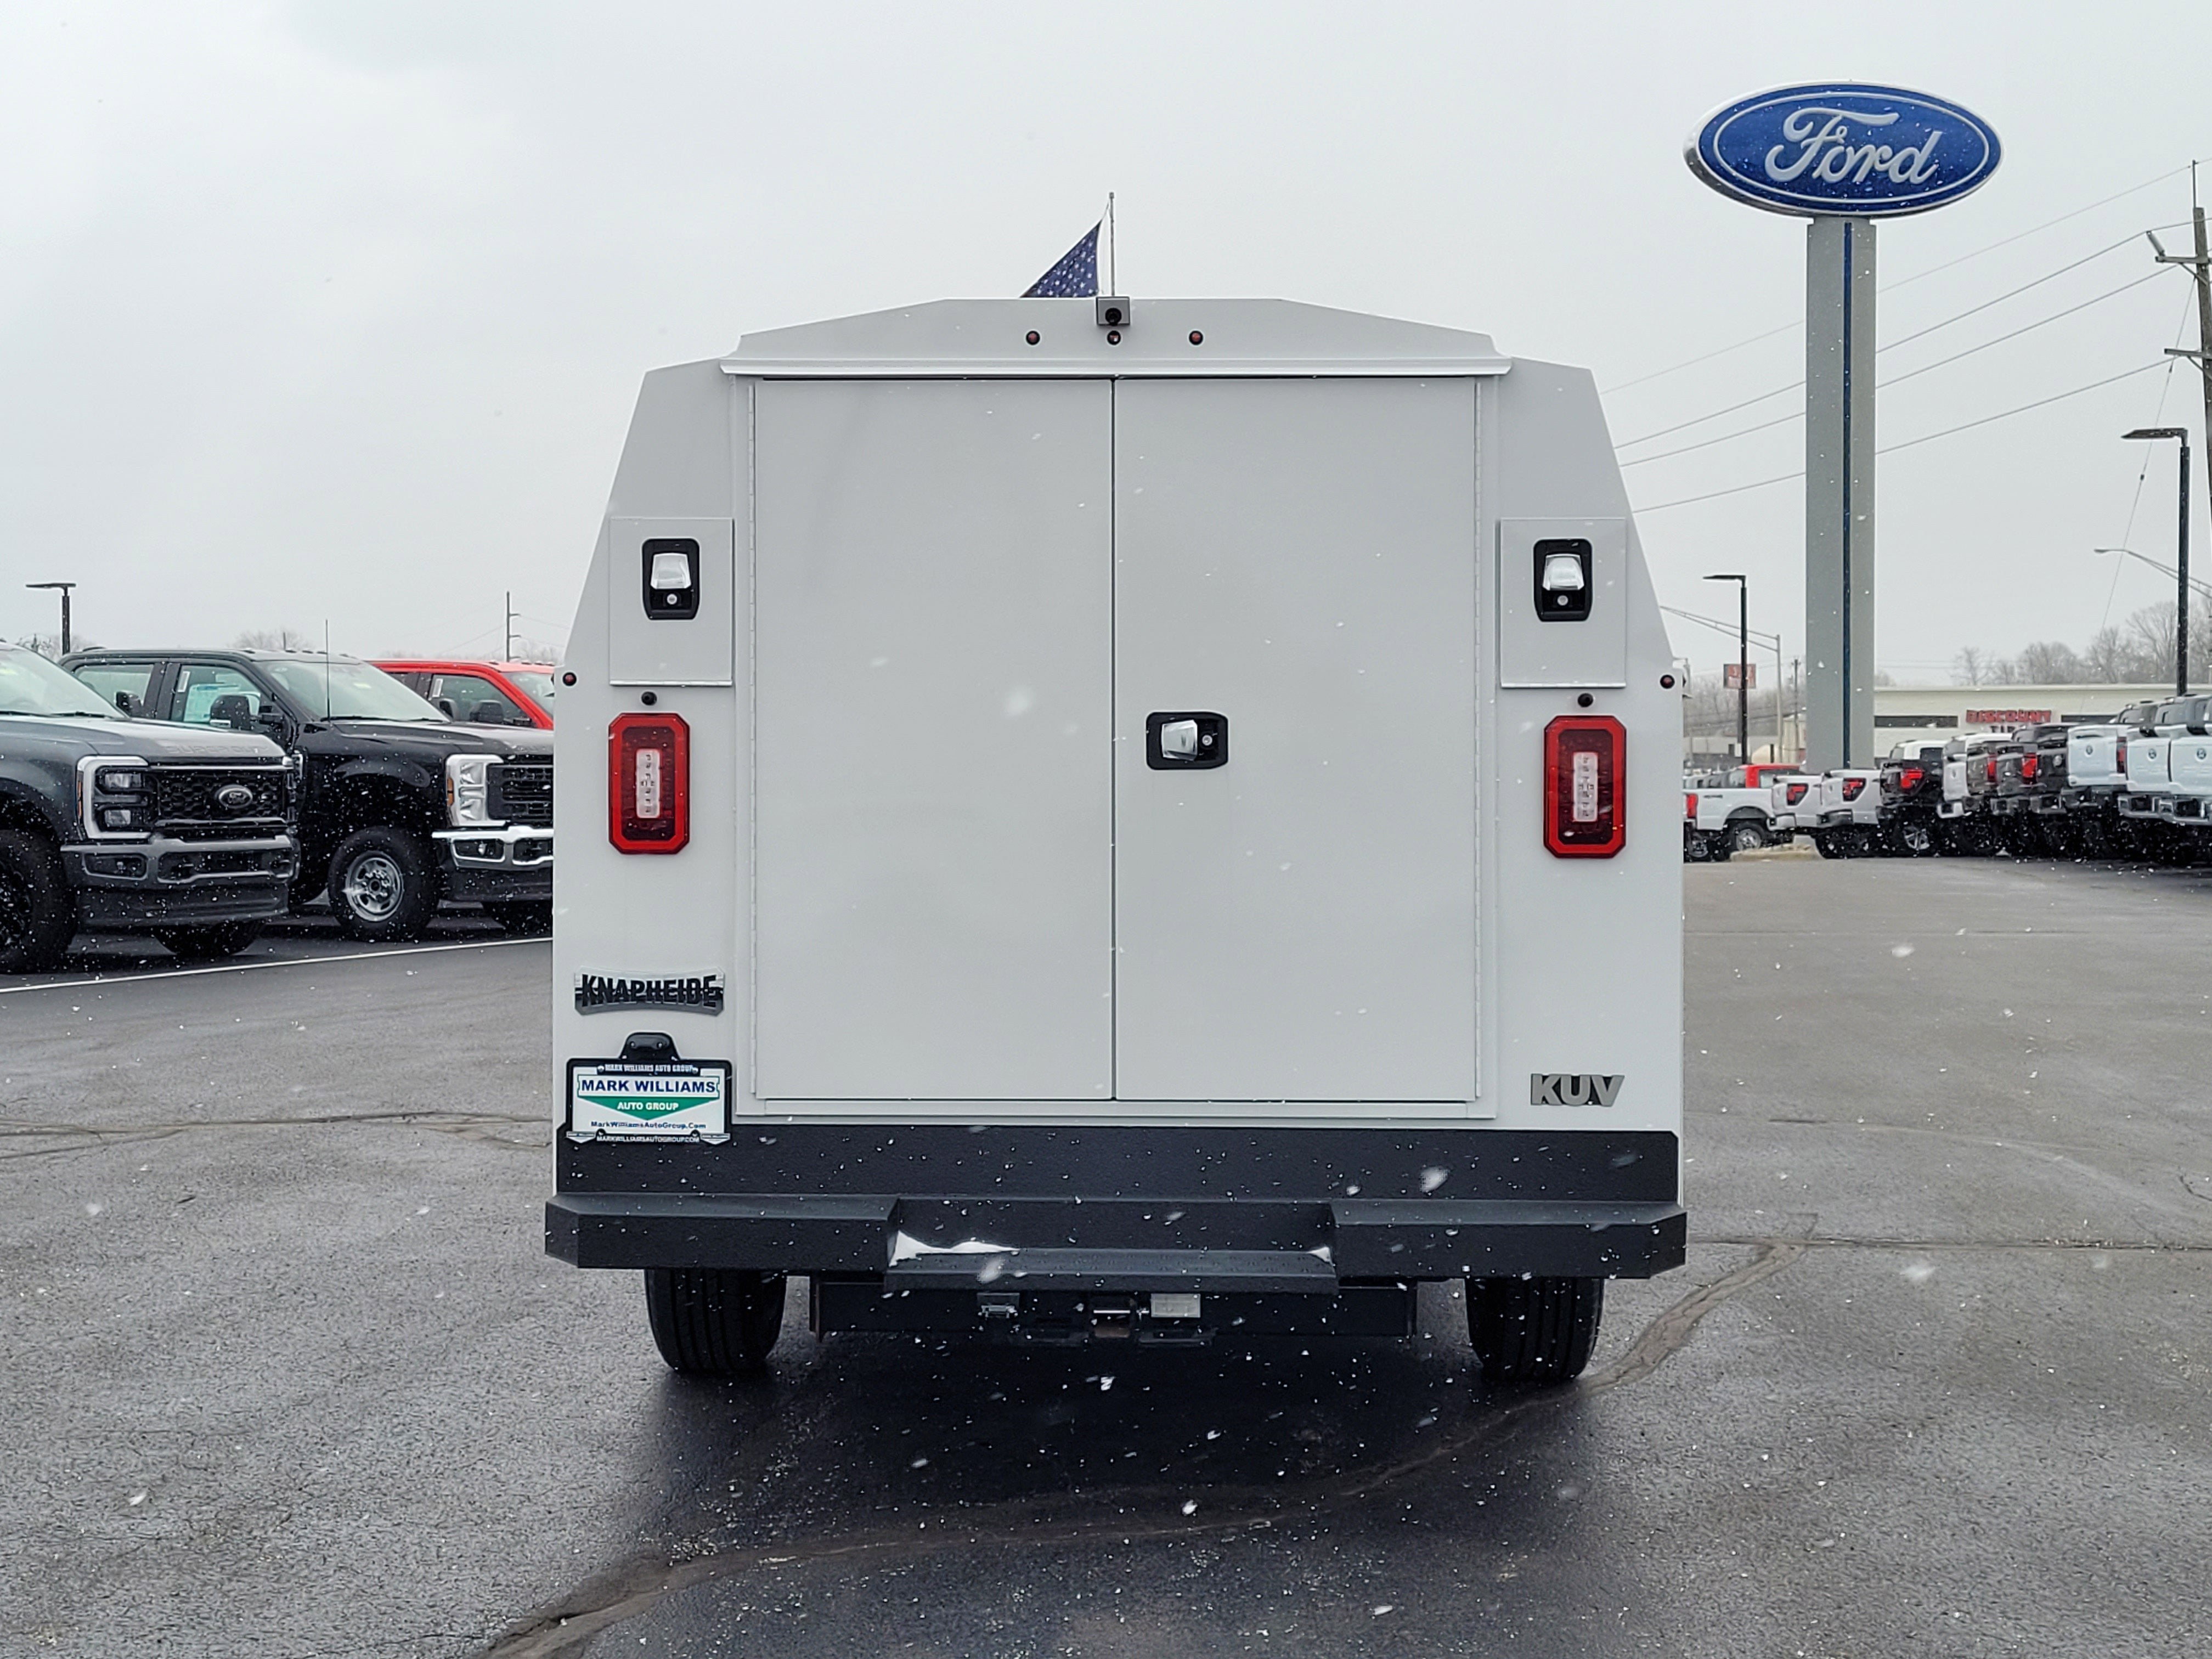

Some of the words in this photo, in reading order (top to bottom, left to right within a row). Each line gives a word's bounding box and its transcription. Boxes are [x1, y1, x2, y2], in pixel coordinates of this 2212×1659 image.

[1765, 107, 1943, 184] Ford
[1966, 709, 2051, 723] DISCOUNT
[582, 974, 716, 1007] KNAPHEIDE
[624, 1064, 654, 1072] WILLIAMS
[672, 1064, 694, 1073] GROUP
[582, 1080, 629, 1091] MARK
[635, 1080, 716, 1093] WILLIAMS
[1531, 1073, 1625, 1107] KUV
[617, 1102, 644, 1110] AUTO
[646, 1102, 679, 1110] GROUP
